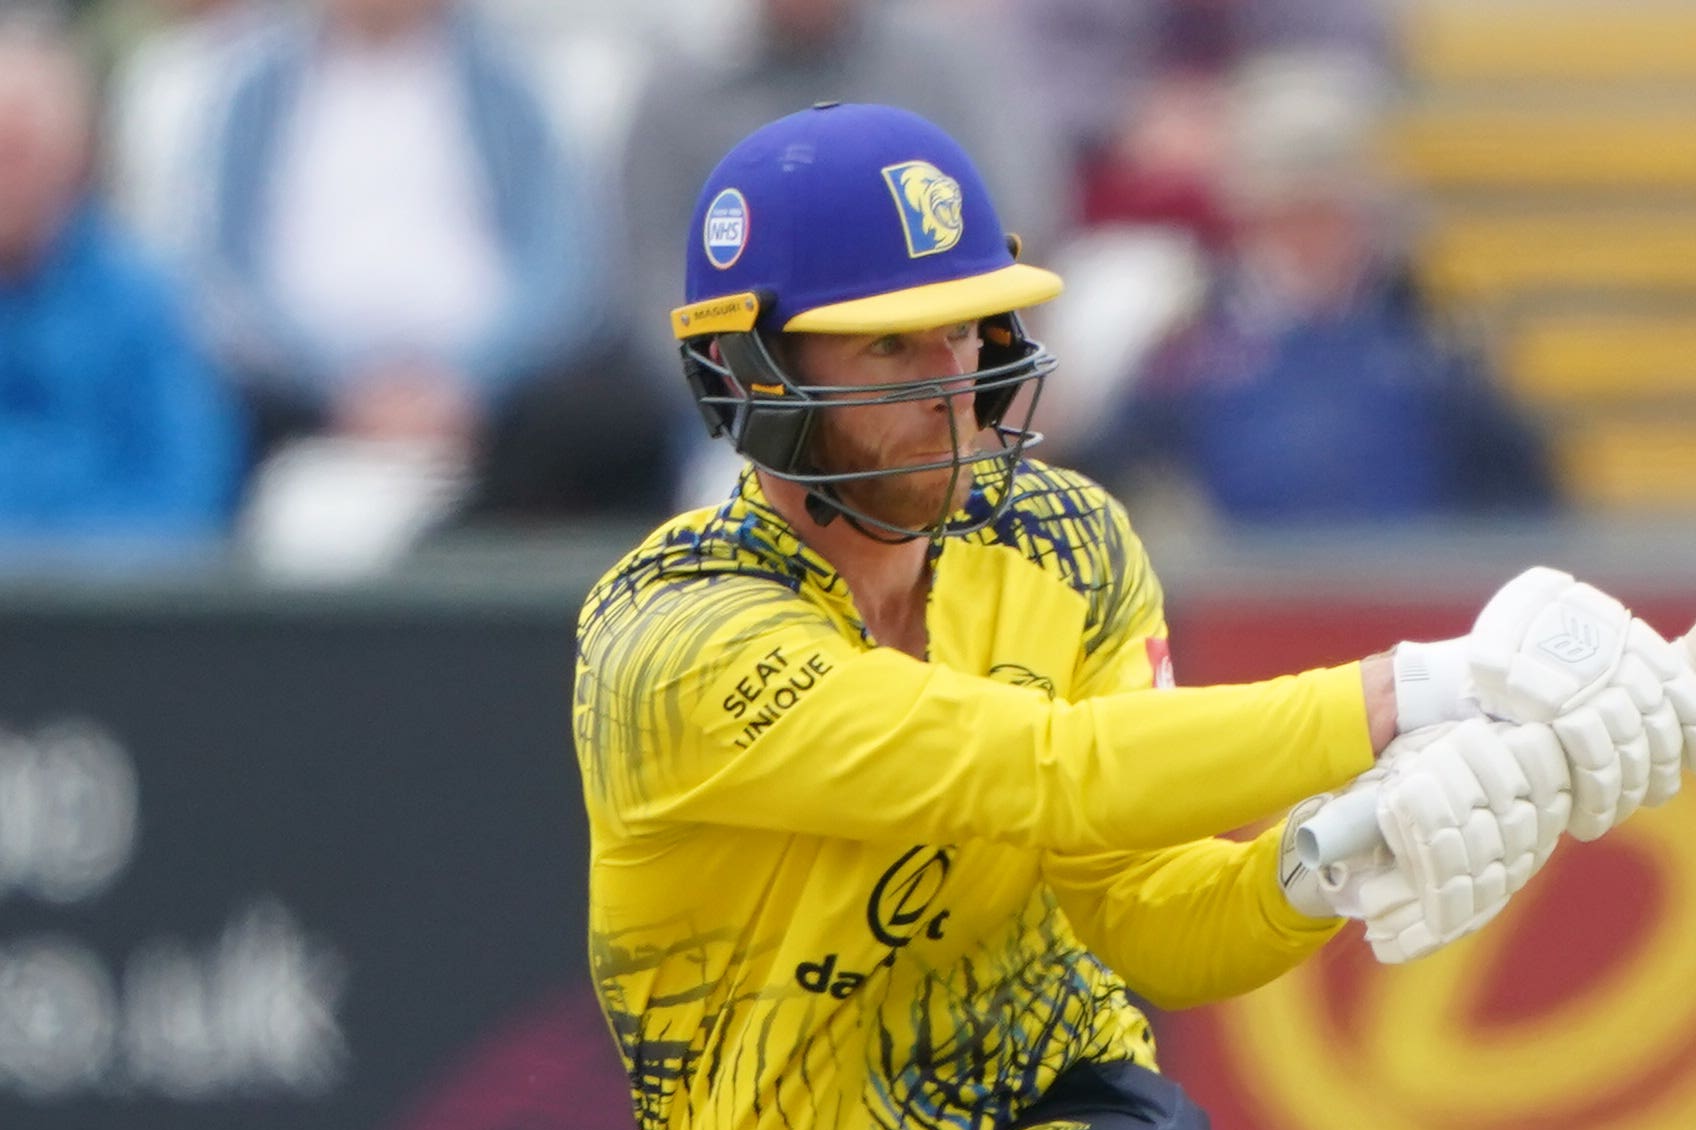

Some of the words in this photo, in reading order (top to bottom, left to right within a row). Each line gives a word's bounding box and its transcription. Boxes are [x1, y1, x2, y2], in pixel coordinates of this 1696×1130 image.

[711, 222, 739, 241] NHS
[723, 646, 788, 719] SEAT
[734, 653, 833, 749] UNIQUE
